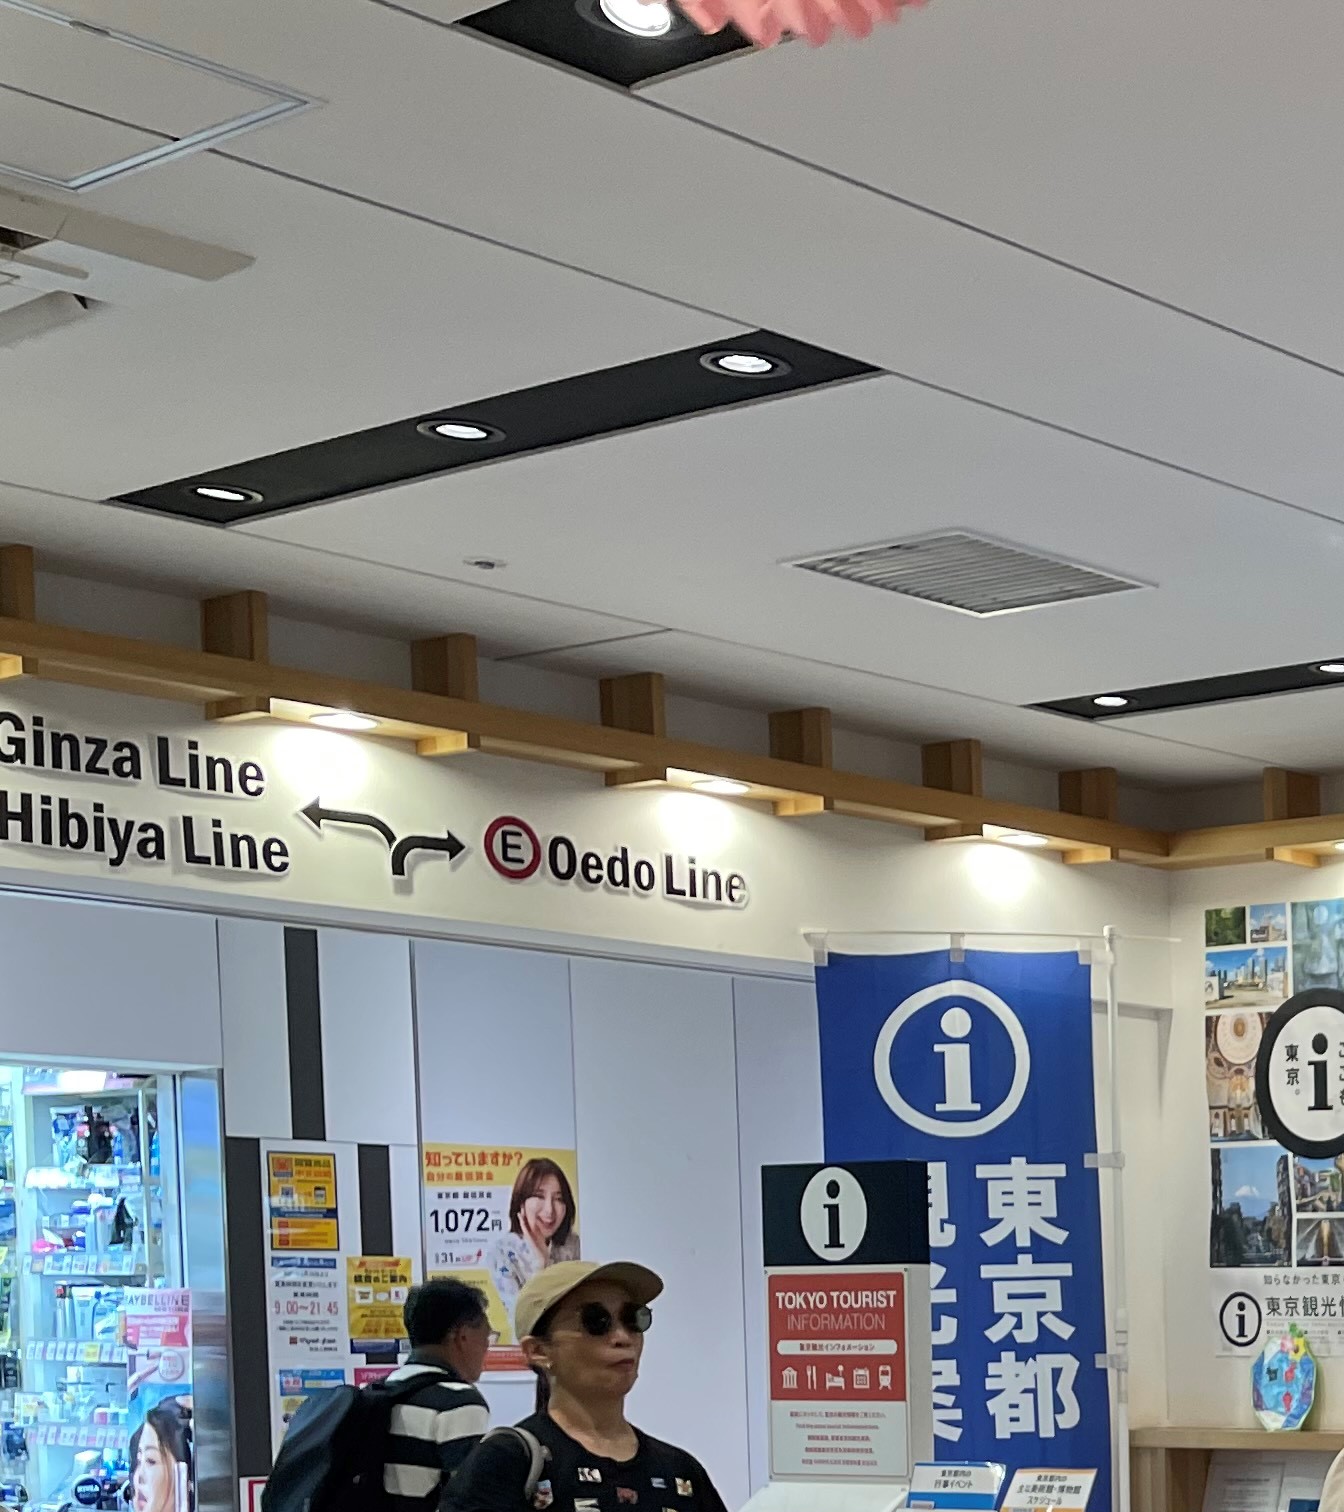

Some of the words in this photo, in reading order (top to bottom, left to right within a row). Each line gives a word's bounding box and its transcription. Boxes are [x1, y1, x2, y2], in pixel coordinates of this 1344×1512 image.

[0, 711, 142, 780] Ginza
[157, 736, 265, 797] Line
[0, 790, 166, 867] Hibiya
[182, 815, 290, 873] Line
[501, 829, 525, 864] E
[548, 836, 655, 892] Oedo
[665, 852, 747, 902] Line
[775, 1291, 828, 1310] TOKYO
[830, 1290, 897, 1309] TOURIST
[974, 1155, 1081, 1441] 東京都
